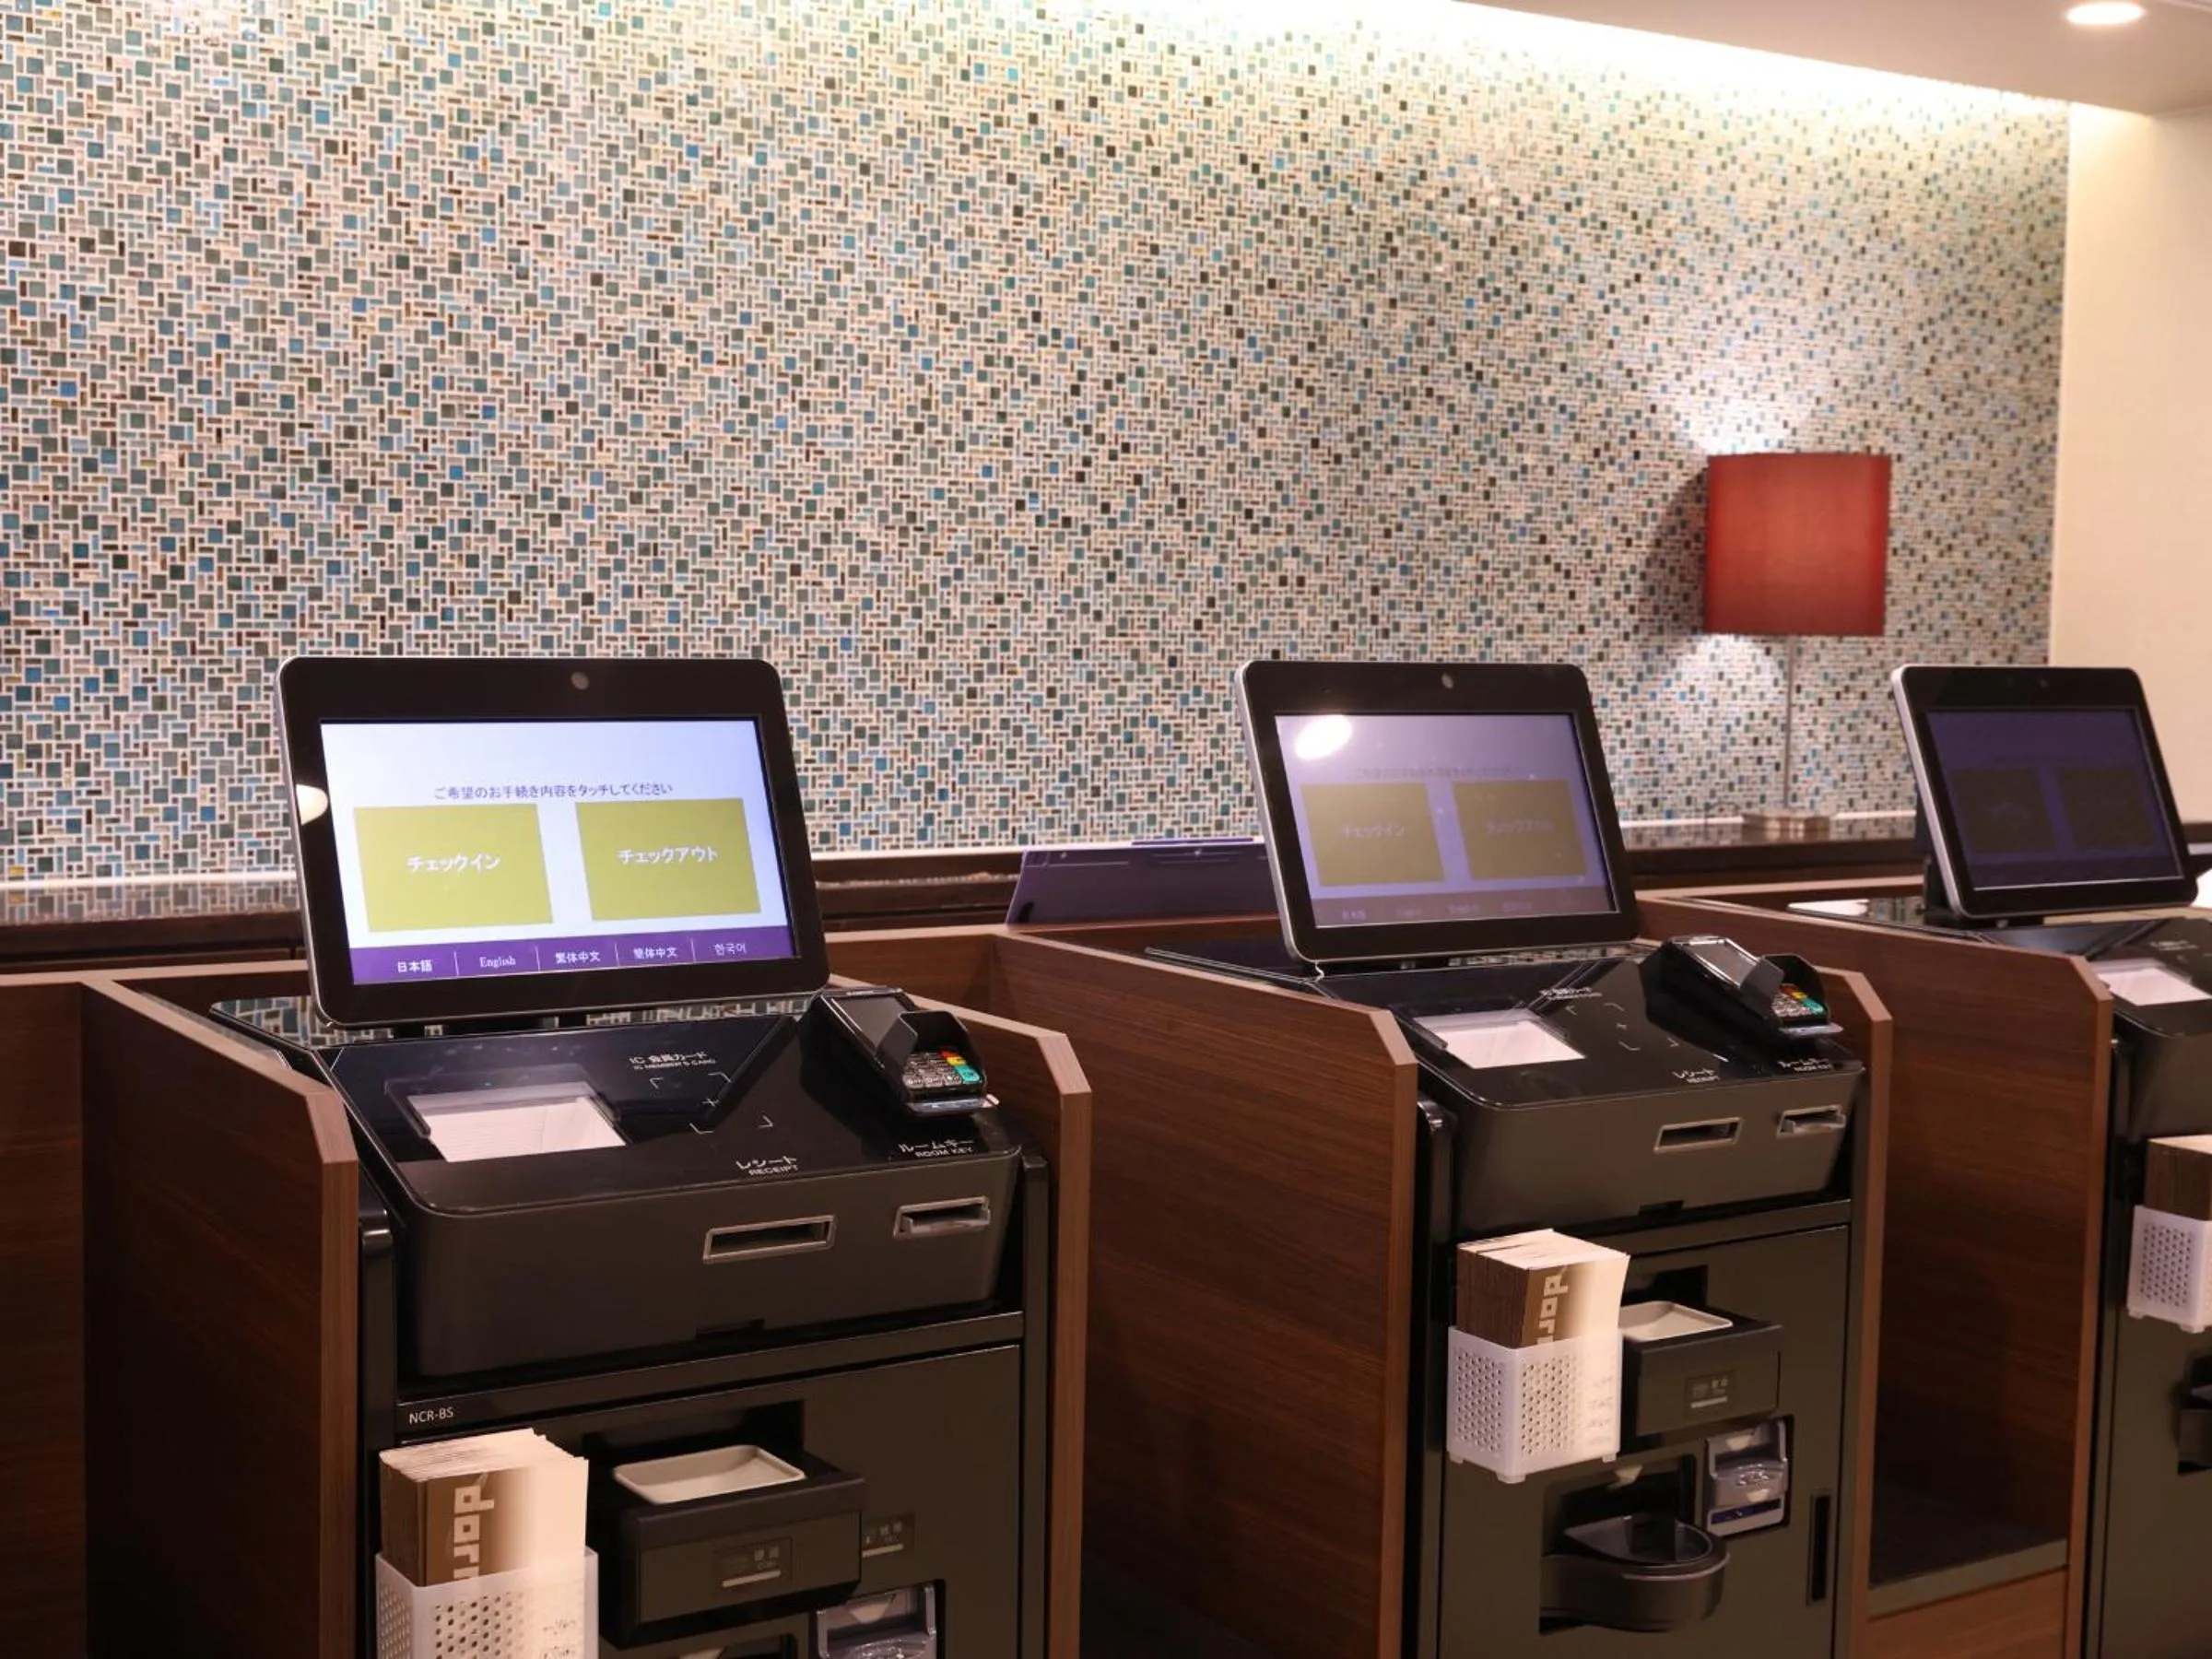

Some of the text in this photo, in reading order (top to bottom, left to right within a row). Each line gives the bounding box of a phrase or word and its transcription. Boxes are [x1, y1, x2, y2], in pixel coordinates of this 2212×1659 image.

[433, 782, 673, 801] ご希望のお手続き内容をタッチしてください
[406, 853, 501, 872] チェックイン
[618, 845, 718, 865] チェックアウト
[714, 942, 747, 957] 한국어
[397, 959, 433, 973] 日本語
[479, 955, 516, 969] English
[735, 1155, 797, 1170] レシート
[408, 1406, 454, 1424] NCR-BS
